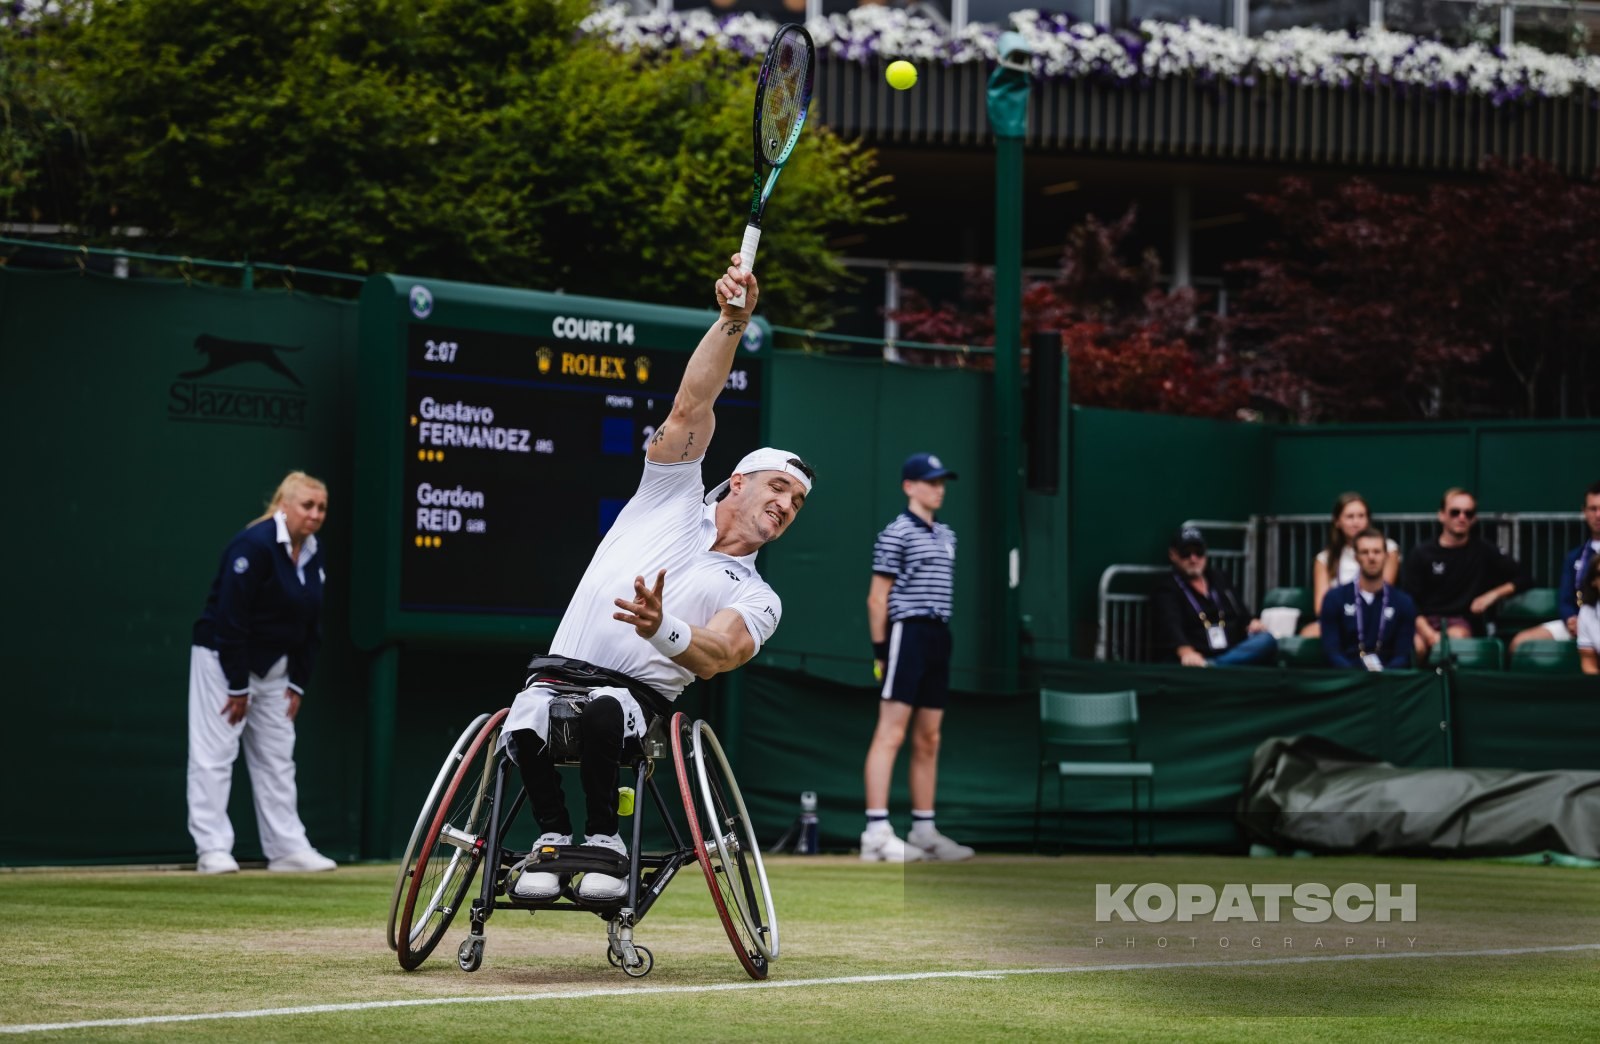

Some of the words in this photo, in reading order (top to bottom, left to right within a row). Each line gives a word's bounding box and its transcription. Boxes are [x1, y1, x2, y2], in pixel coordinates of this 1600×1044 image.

[552, 315, 613, 343] COURT
[615, 322, 635, 345] 14
[424, 339, 458, 363] 2:07
[561, 352, 625, 379] ROLEX
[168, 380, 307, 428] Slazenger
[419, 396, 494, 425] Gustavo
[419, 421, 531, 452] FERNANDEZ
[416, 482, 484, 509] Gordon
[416, 507, 462, 532] REID
